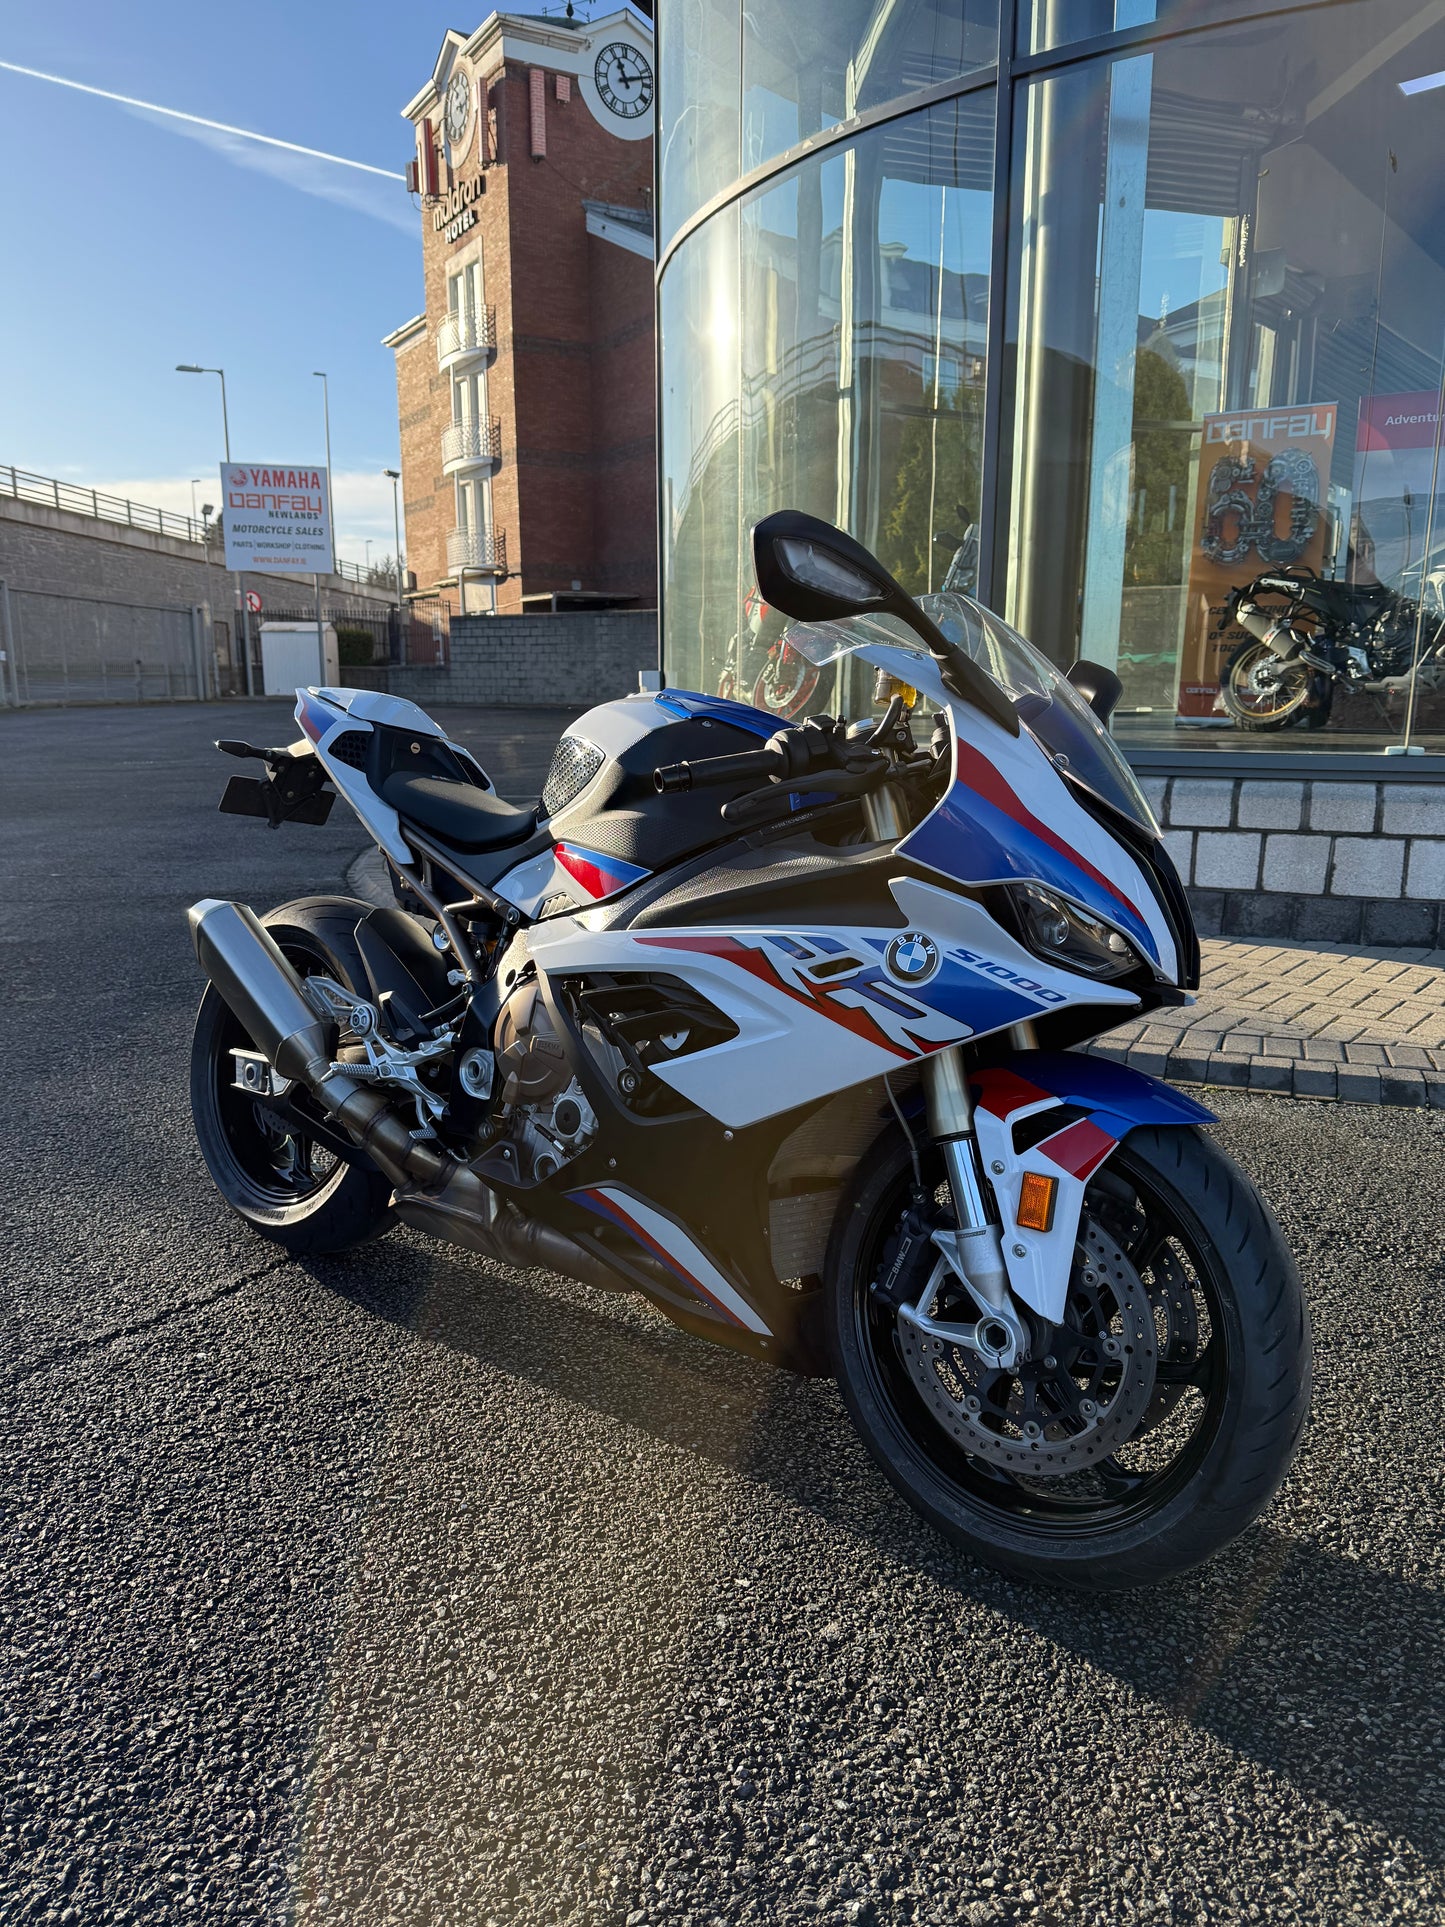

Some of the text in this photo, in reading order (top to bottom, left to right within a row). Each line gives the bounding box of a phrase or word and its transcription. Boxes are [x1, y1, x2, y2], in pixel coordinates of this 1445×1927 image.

[433, 173, 481, 232] maldron
[444, 208, 475, 244] HOTEL
[1385, 412, 1445, 426] Adventu
[250, 468, 321, 490] YAMAHA
[268, 510, 319, 520] NEWLANDS
[232, 524, 324, 536] MOTORCYCLE SALES
[294, 543, 325, 551] CLOTHING
[946, 948, 1068, 1003] S1000
